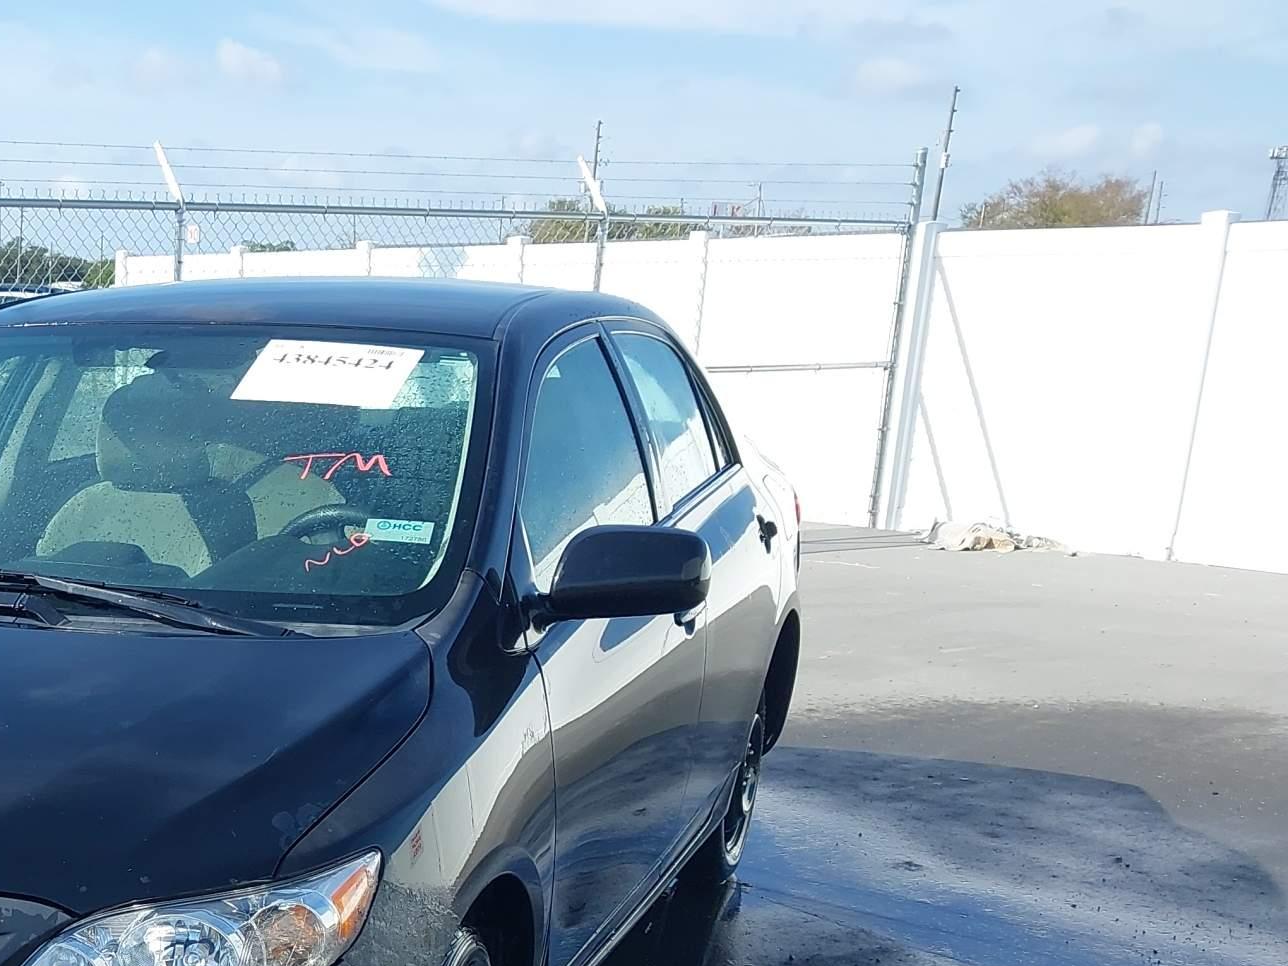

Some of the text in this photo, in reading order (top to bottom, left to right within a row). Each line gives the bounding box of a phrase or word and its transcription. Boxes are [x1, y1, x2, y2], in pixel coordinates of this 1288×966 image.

[272, 352, 395, 371] 43845424
[282, 452, 393, 480] TM
[392, 523, 423, 532] HCC
